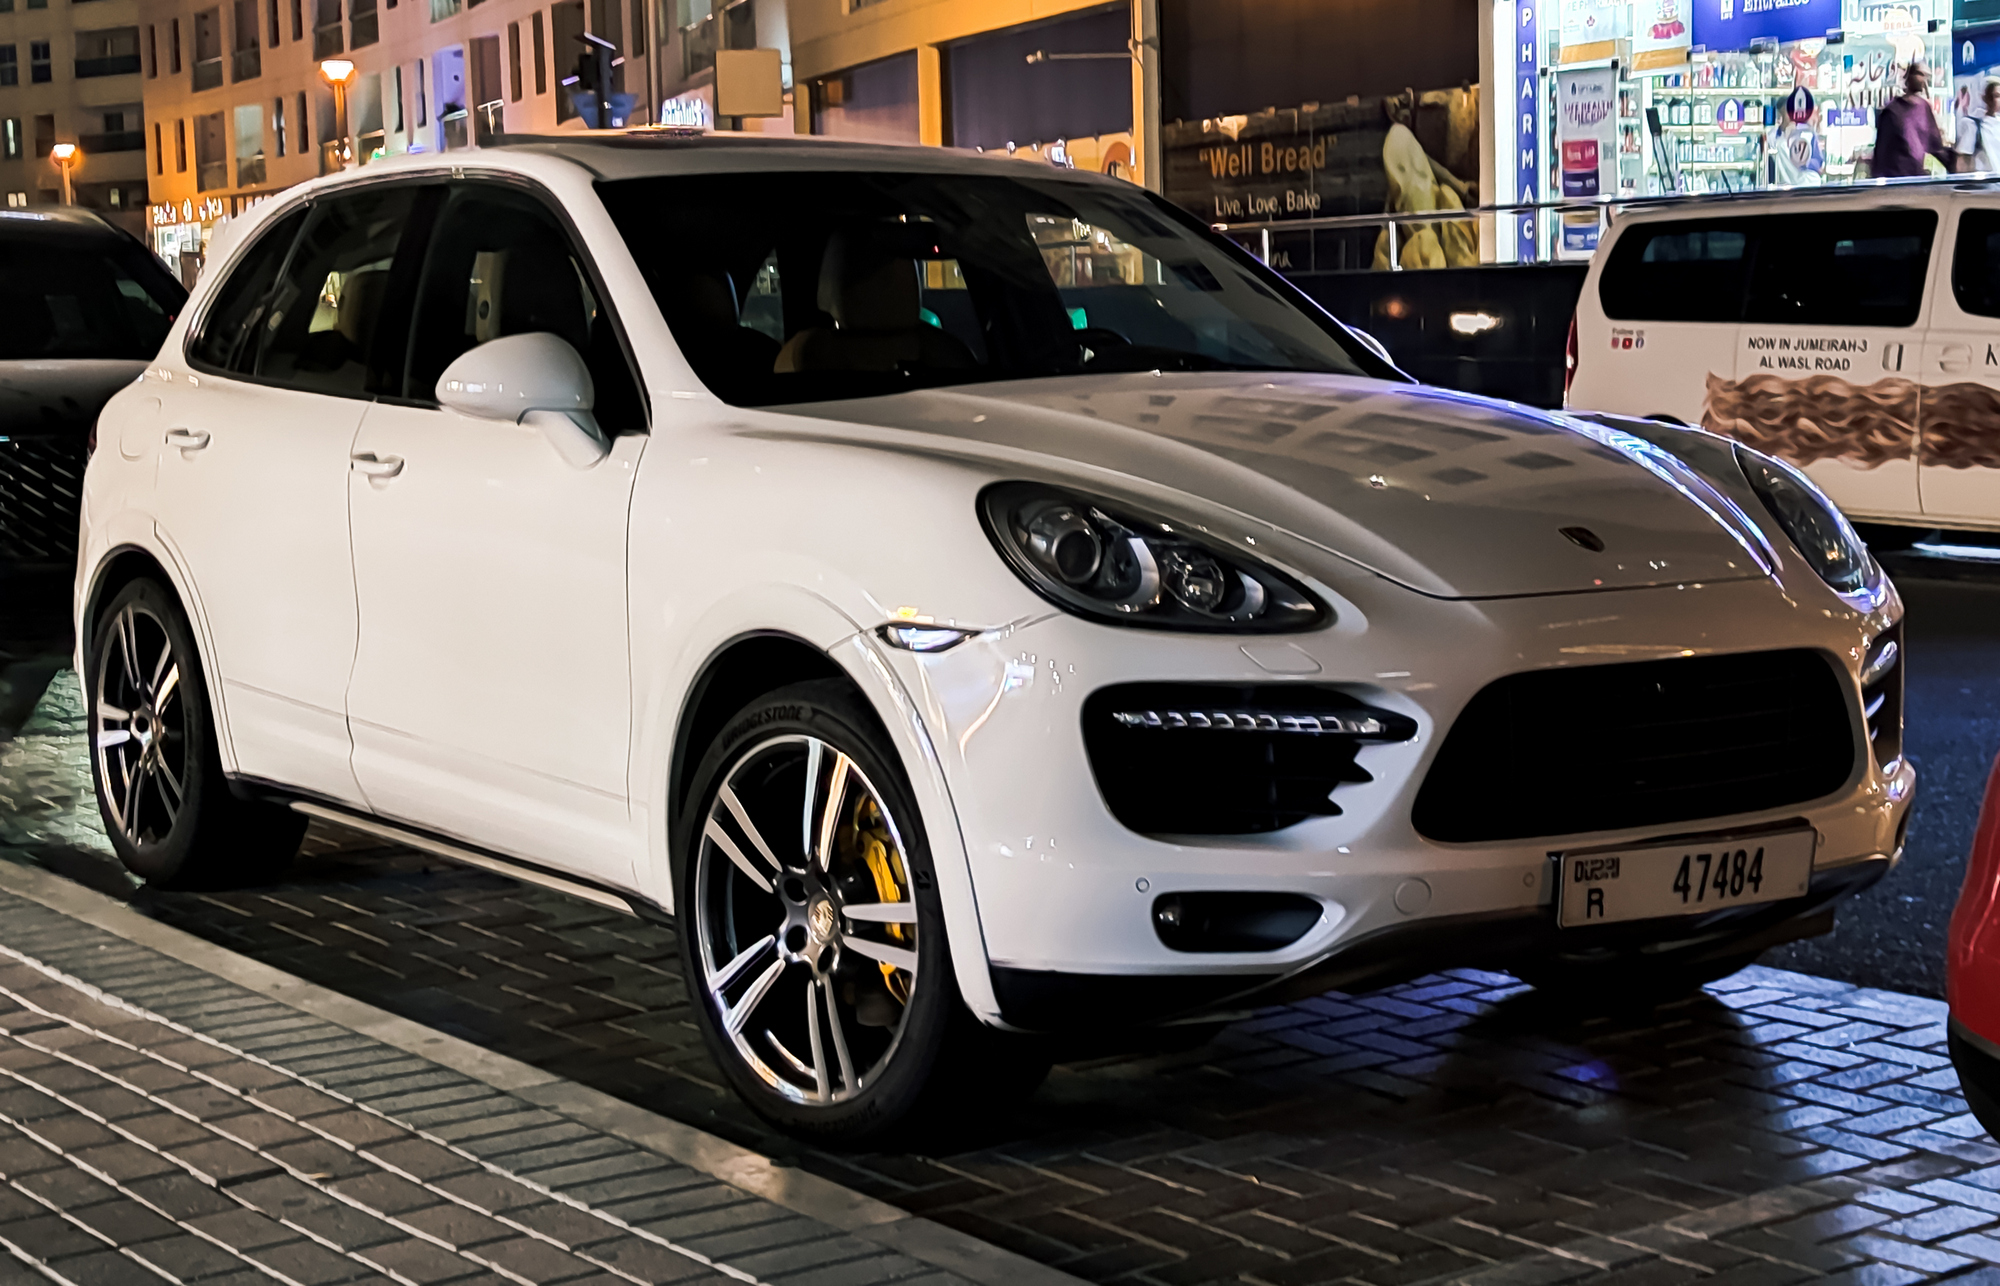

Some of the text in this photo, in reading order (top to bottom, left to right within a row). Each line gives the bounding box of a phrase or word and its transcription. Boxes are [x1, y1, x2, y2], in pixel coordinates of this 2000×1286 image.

[1520, 7, 1534, 263] PHARMAC
[1286, 189, 1320, 212] Bake
[1748, 337, 1776, 350] NOW
[1779, 338, 1791, 350] IN
[1759, 355, 1850, 371] AL WASL ROAD
[1673, 847, 1764, 903] 47484
[1586, 887, 1604, 919] R
